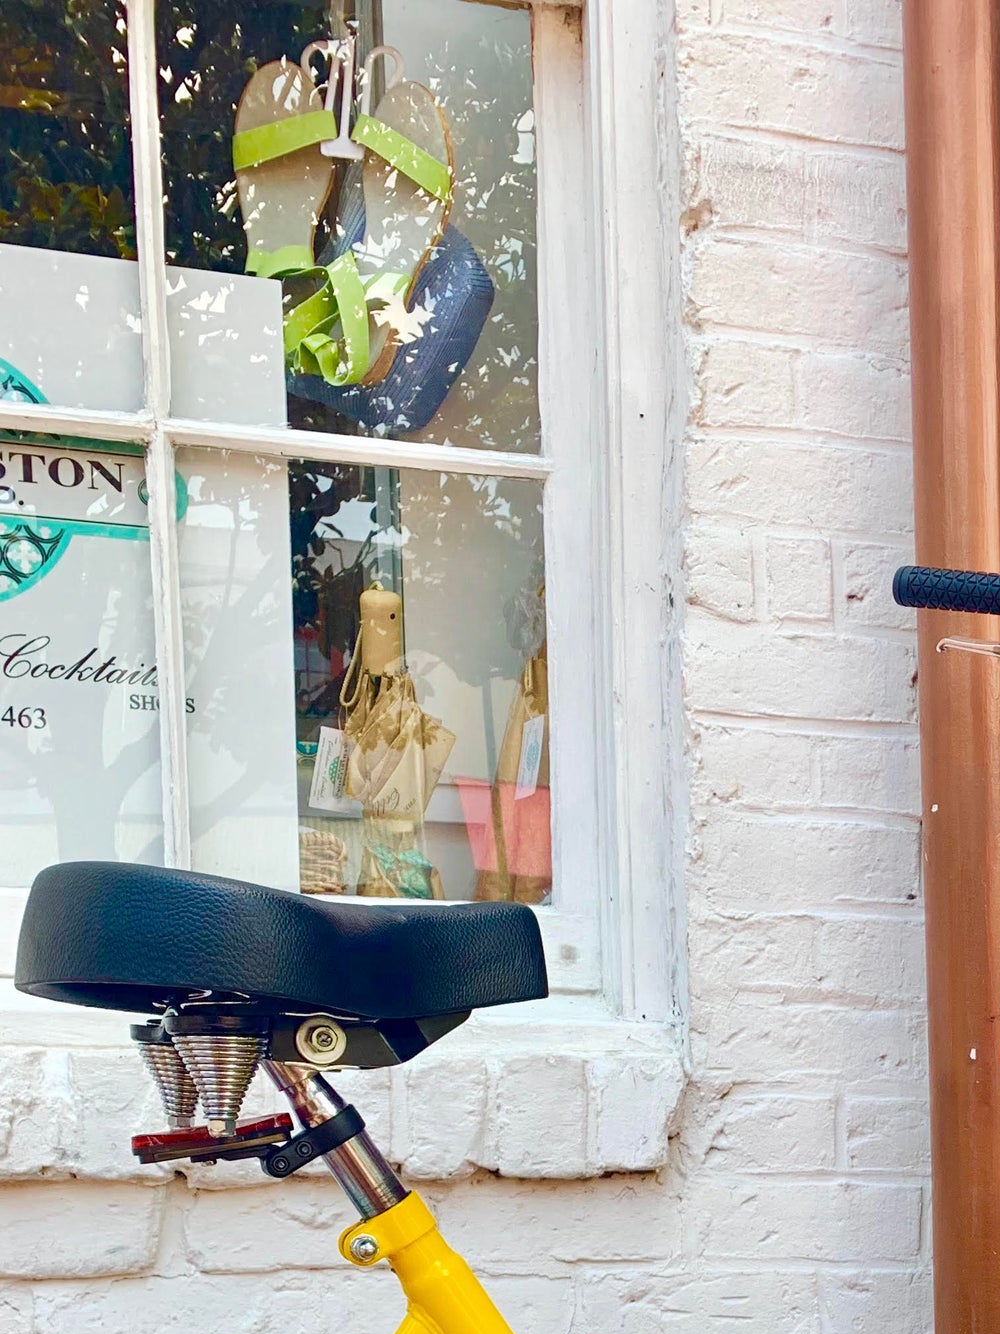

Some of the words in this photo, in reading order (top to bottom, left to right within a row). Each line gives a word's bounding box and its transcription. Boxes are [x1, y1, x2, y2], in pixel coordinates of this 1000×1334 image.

[0, 449, 126, 493] TON
[129, 693, 196, 715] SHS
[0, 705, 47, 730] 463
